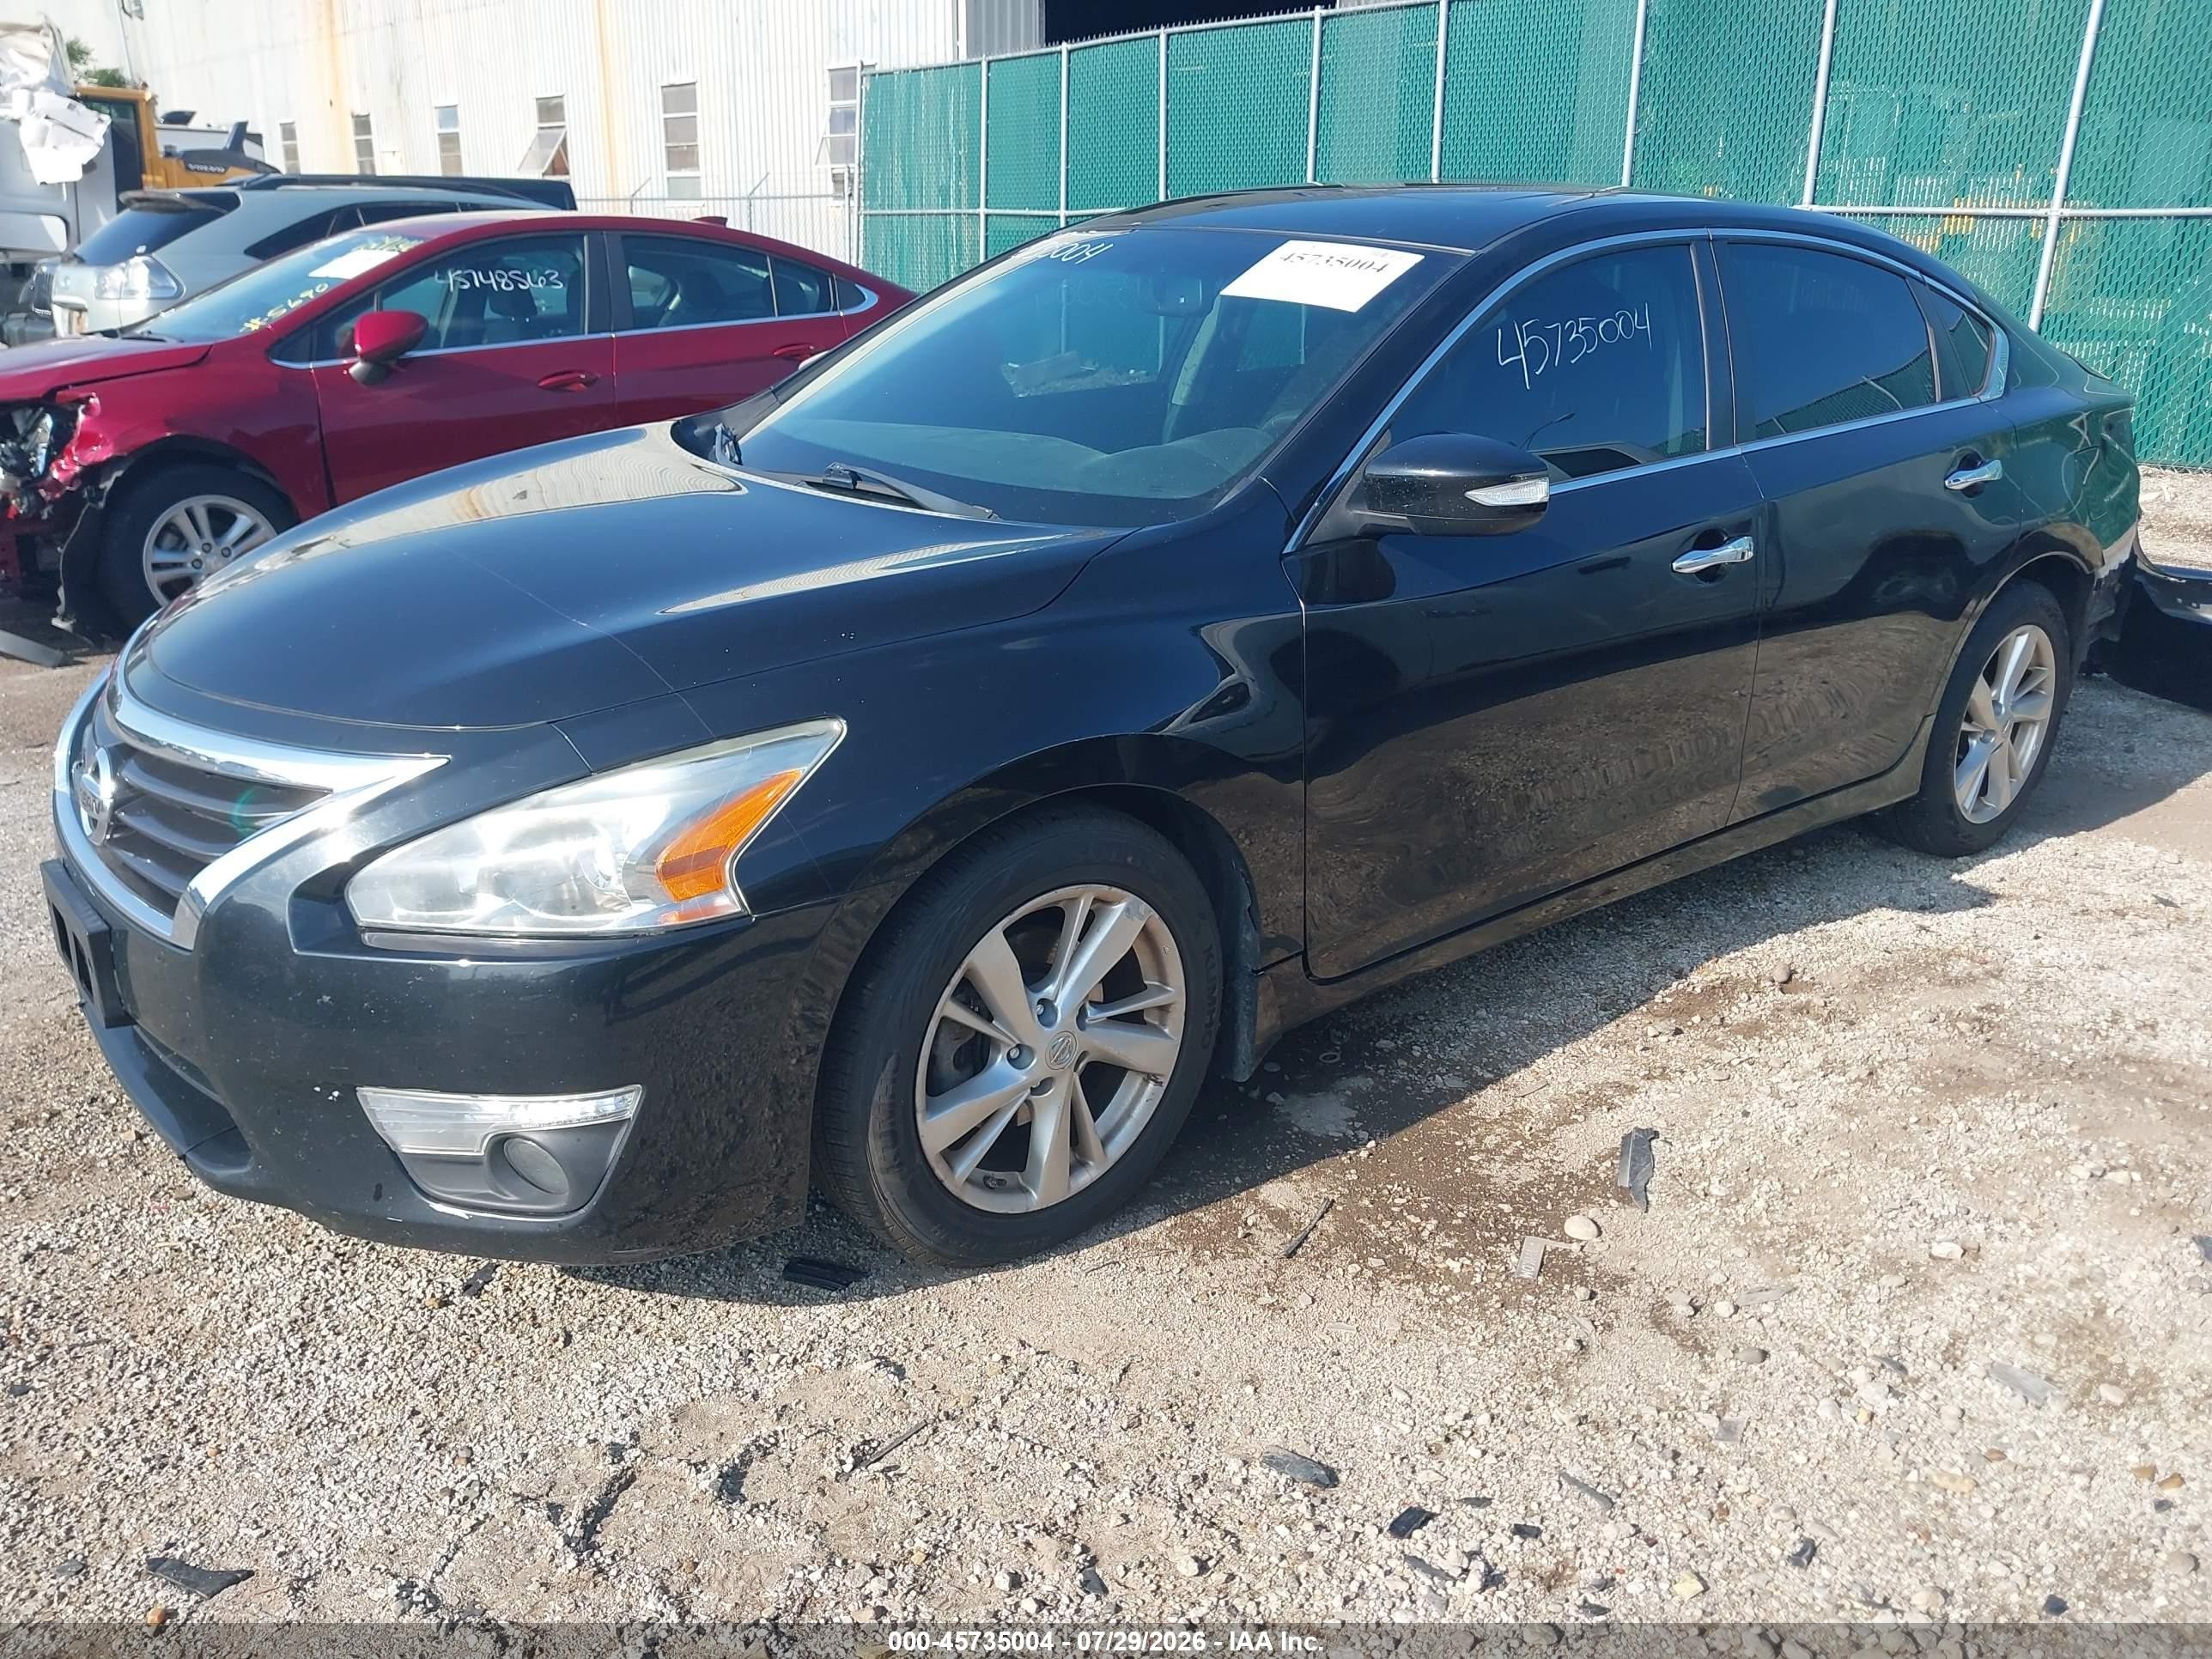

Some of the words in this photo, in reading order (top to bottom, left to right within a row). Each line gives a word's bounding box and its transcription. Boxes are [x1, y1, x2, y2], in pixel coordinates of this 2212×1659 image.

[1279, 252, 1390, 273] 45735004
[434, 269, 564, 292] 45748563
[1497, 301, 1653, 390] 45735004
